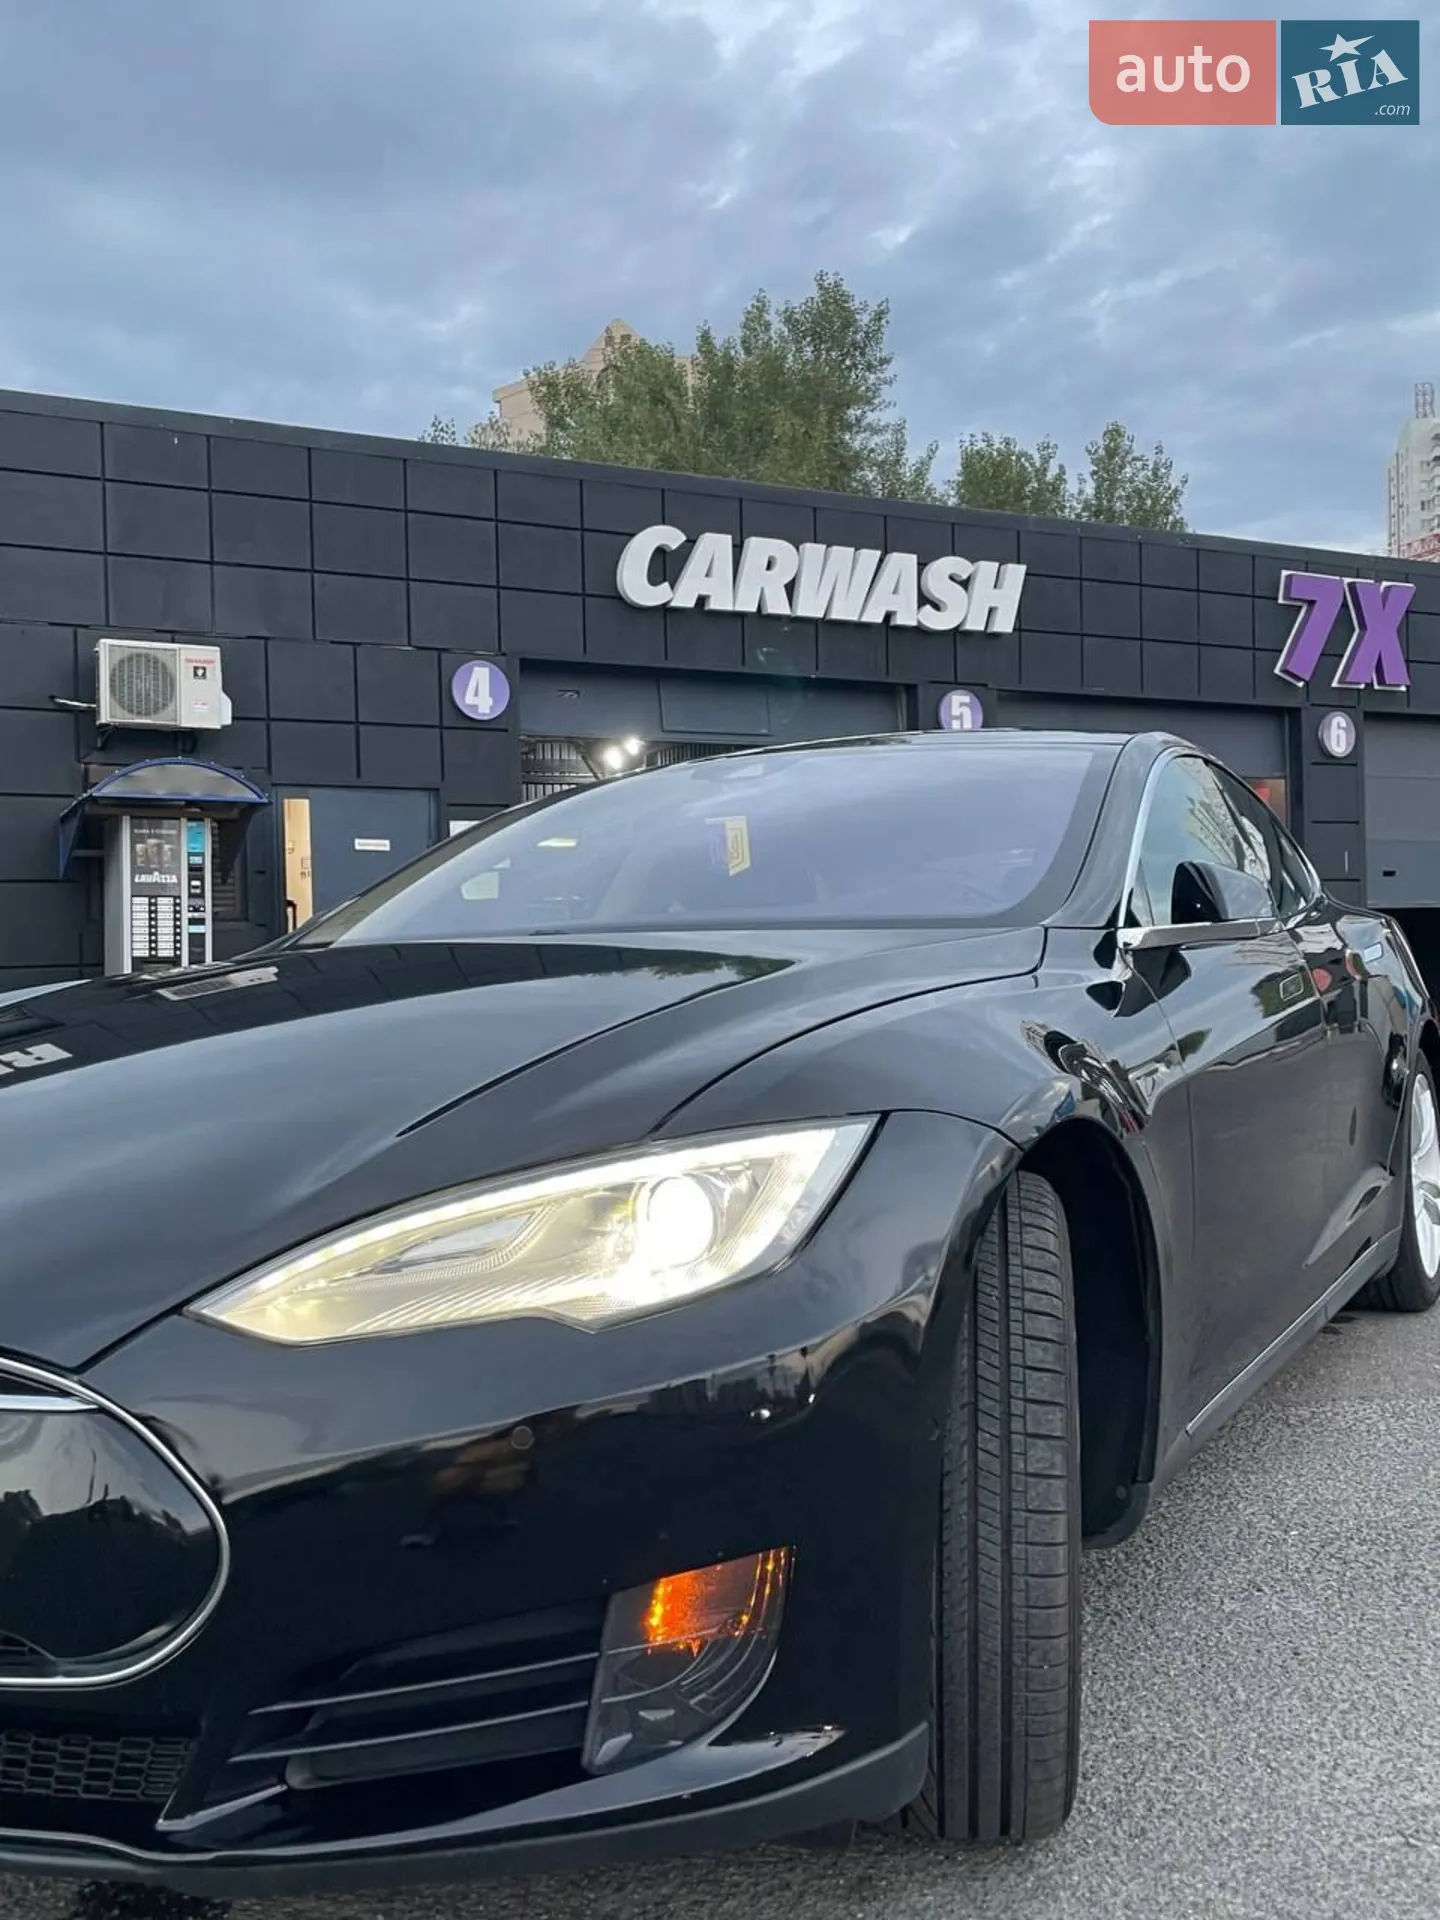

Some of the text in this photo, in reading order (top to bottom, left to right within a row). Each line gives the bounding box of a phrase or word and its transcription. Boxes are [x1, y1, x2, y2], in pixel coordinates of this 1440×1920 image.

[616, 525, 1027, 634] CARWASH
[1273, 569, 1417, 692] 7X
[464, 666, 494, 714] 4
[950, 695, 973, 730] 5
[1329, 715, 1347, 753] 6
